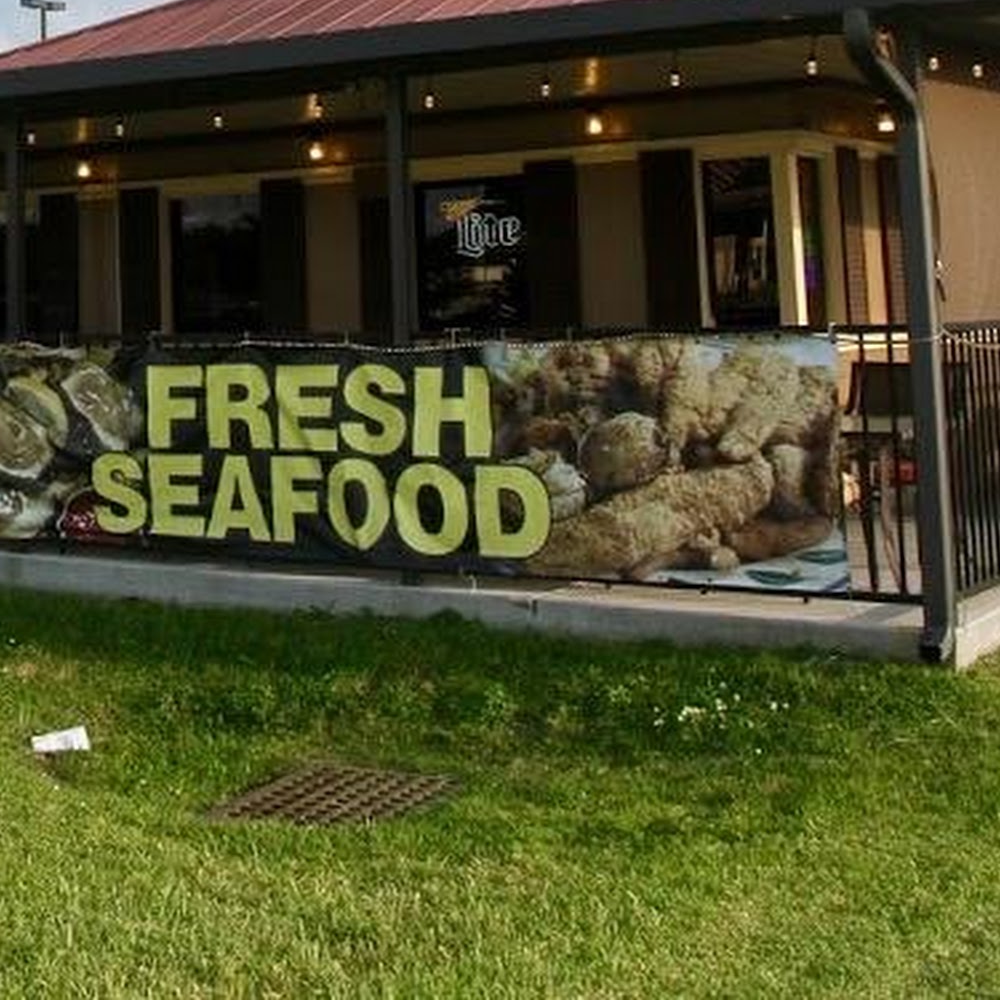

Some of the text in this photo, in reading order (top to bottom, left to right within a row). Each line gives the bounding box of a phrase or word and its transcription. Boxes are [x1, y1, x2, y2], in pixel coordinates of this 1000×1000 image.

[456, 212, 522, 258] Lite
[146, 363, 493, 458] FRESH
[91, 452, 552, 559] SEAFOOD
